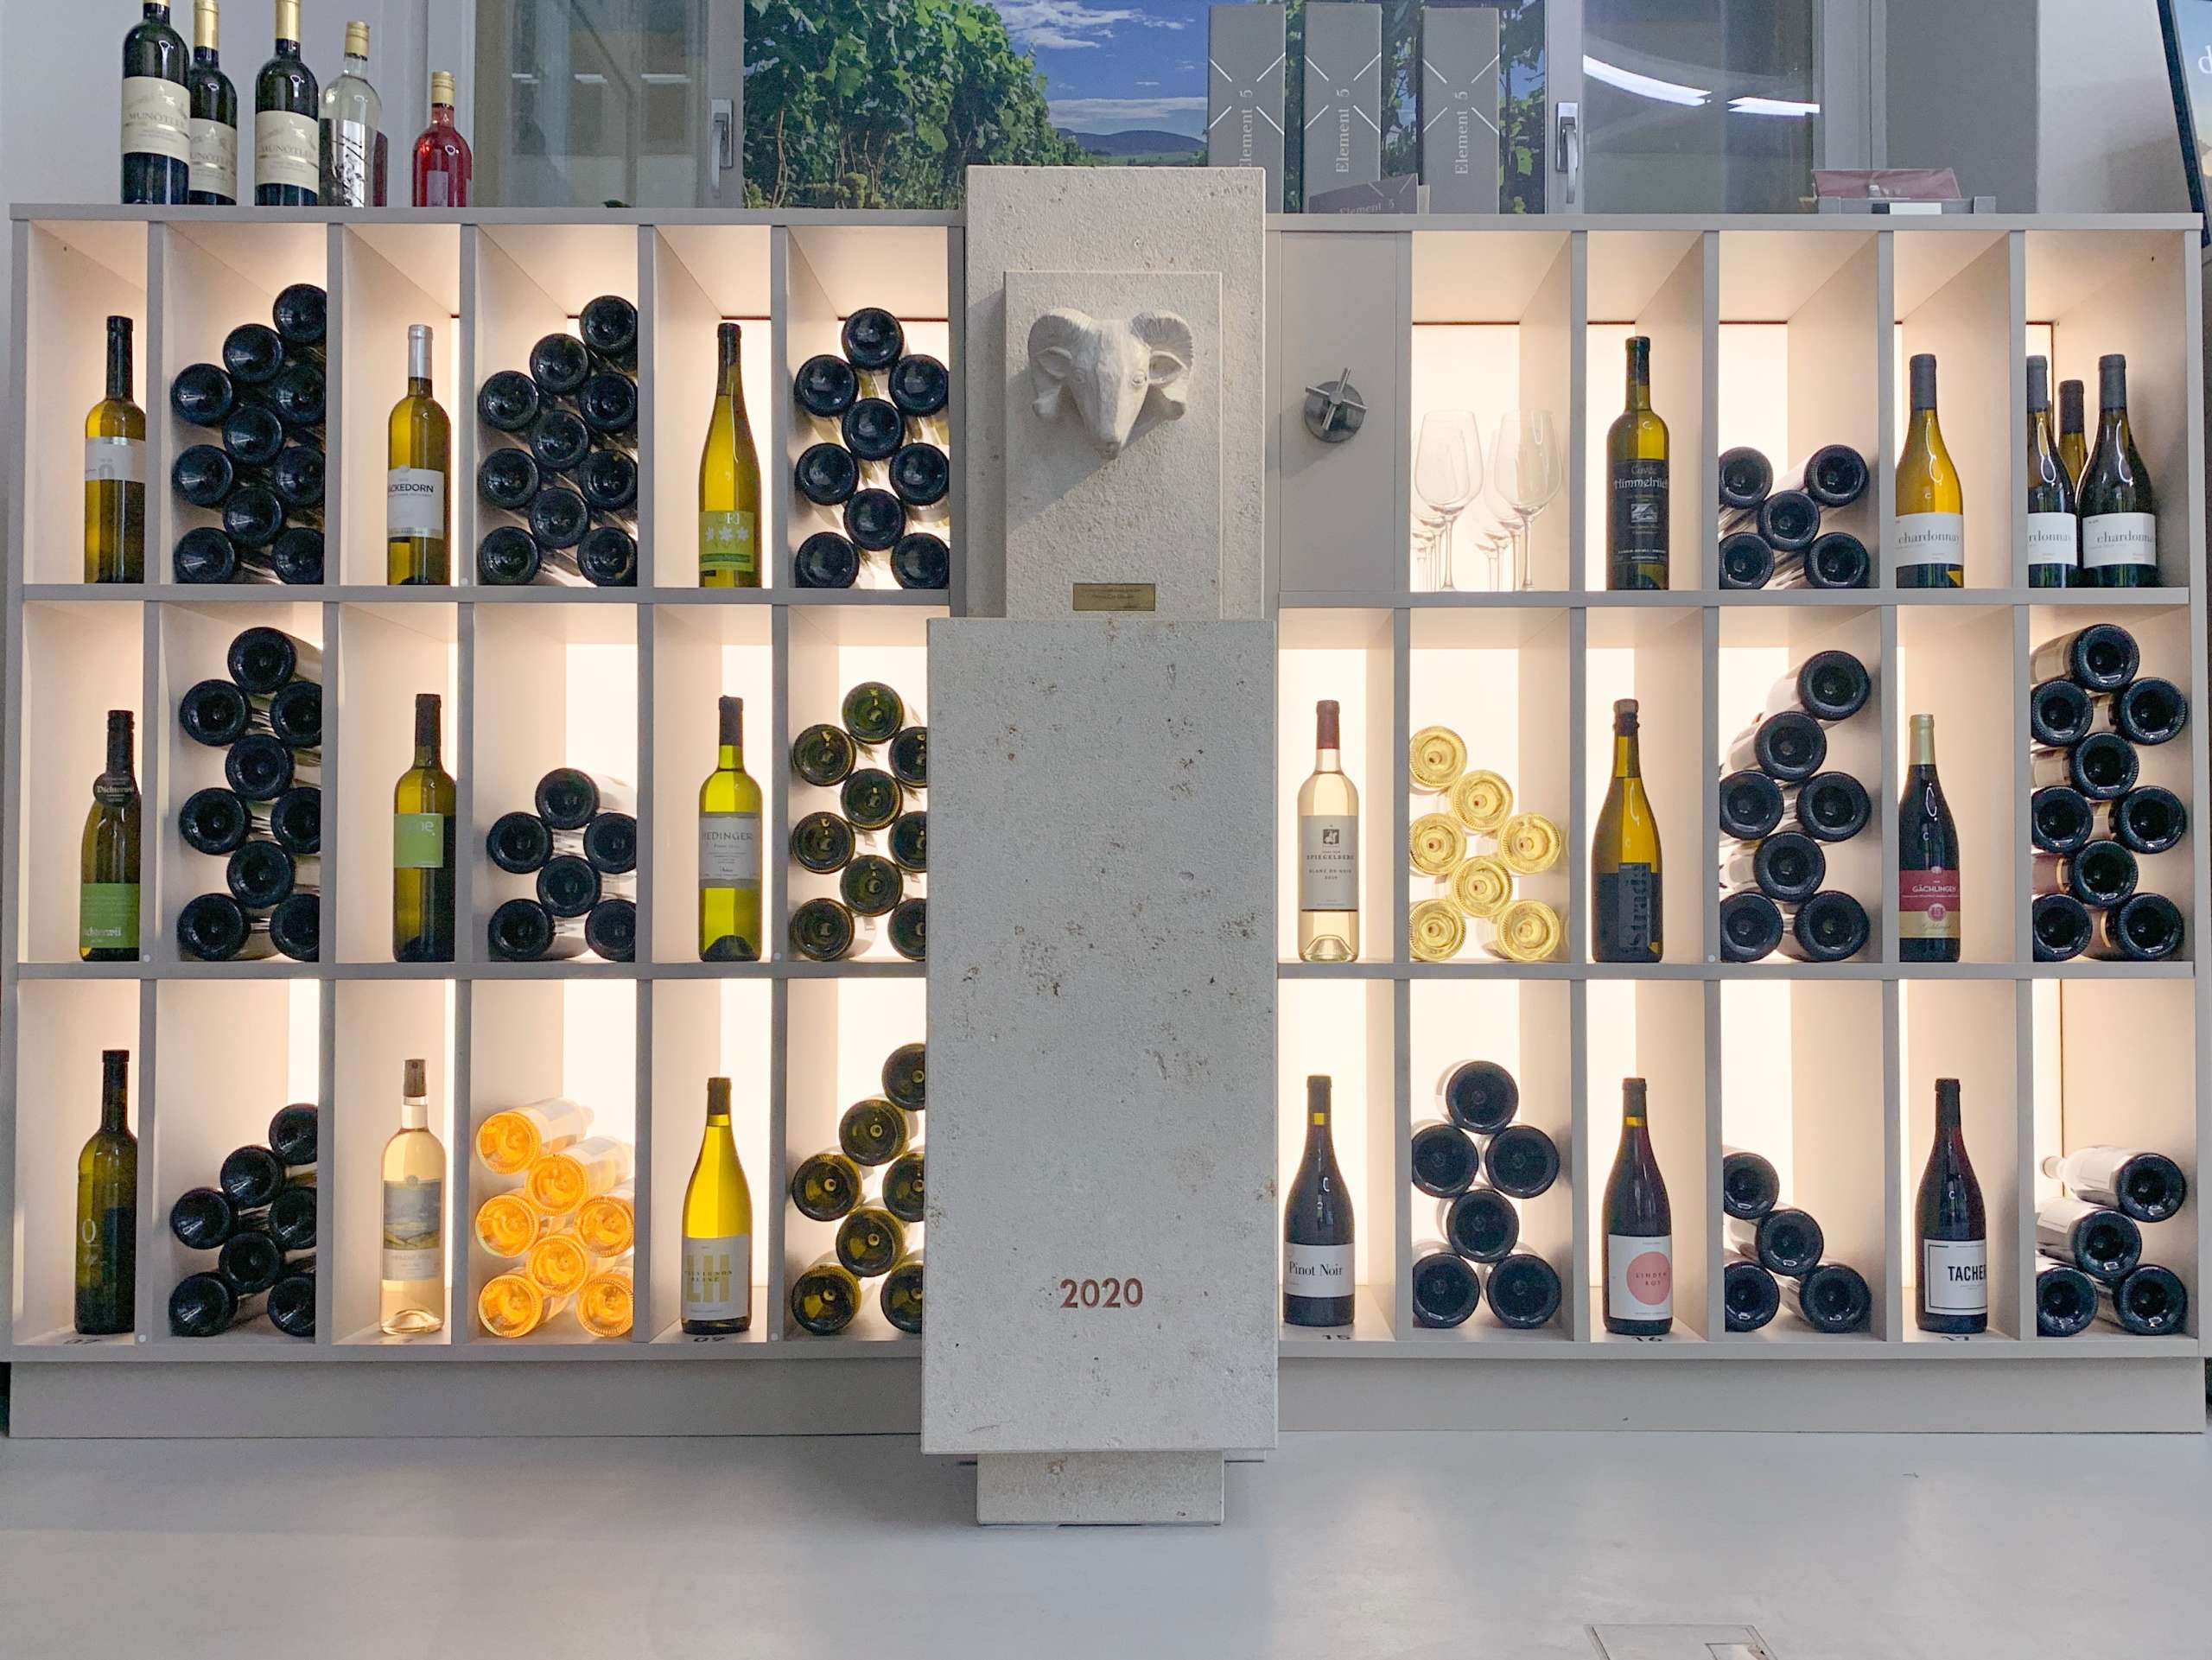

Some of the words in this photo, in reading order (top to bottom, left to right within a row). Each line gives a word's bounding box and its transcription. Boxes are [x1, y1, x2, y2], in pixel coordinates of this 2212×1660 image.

[1240, 89, 1253, 98] 5
[1337, 88, 1350, 98] 5
[1455, 91, 1469, 100] 5
[1336, 107, 1350, 174] Element
[1455, 110, 1469, 175] Element
[1339, 201, 1382, 213] Element
[1288, 1260, 1315, 1276] Pinot
[1319, 1262, 1344, 1276] Noir
[1059, 1277, 1143, 1308] 2020
